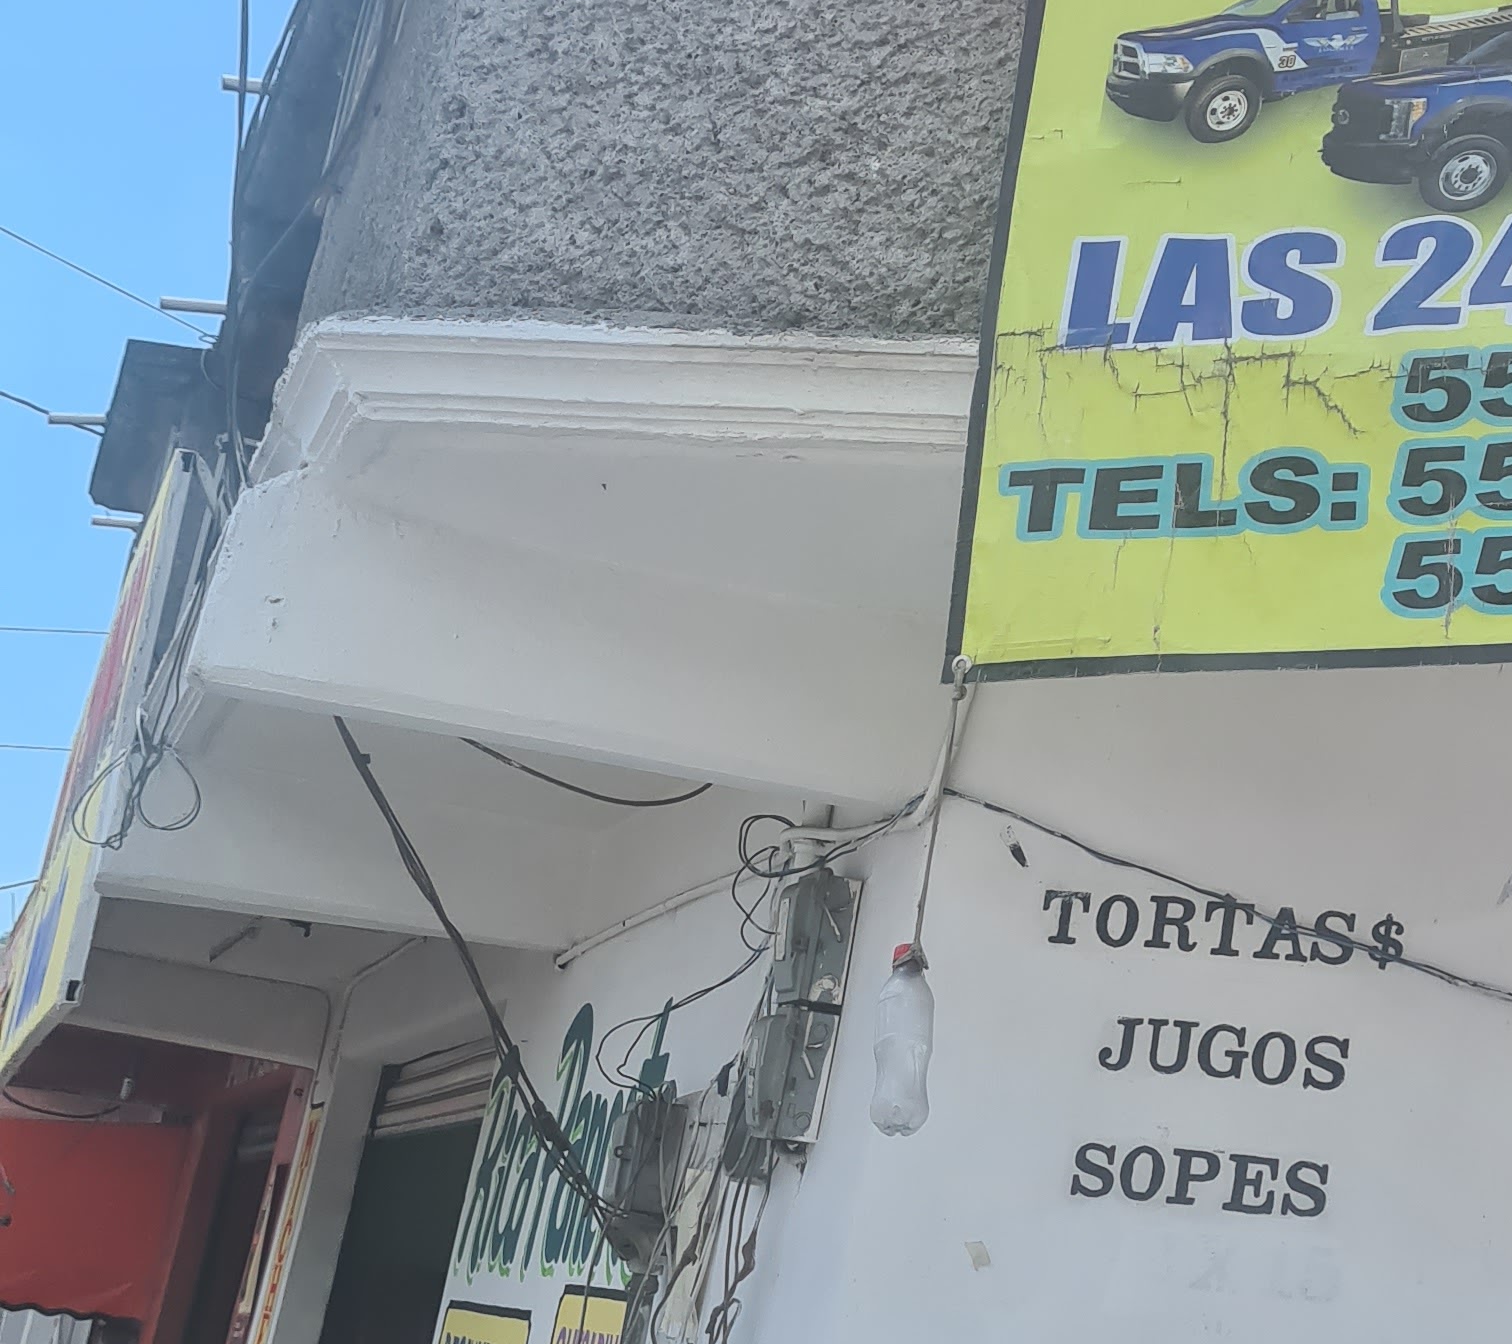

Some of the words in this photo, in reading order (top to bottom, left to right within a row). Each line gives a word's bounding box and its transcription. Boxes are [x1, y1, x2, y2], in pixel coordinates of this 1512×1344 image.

[1061, 229, 1342, 350] LAS
[1008, 452, 1360, 533] TELS:
[1098, 1017, 1350, 1091] JUGOS
[1070, 1143, 1329, 1217] SOPES
